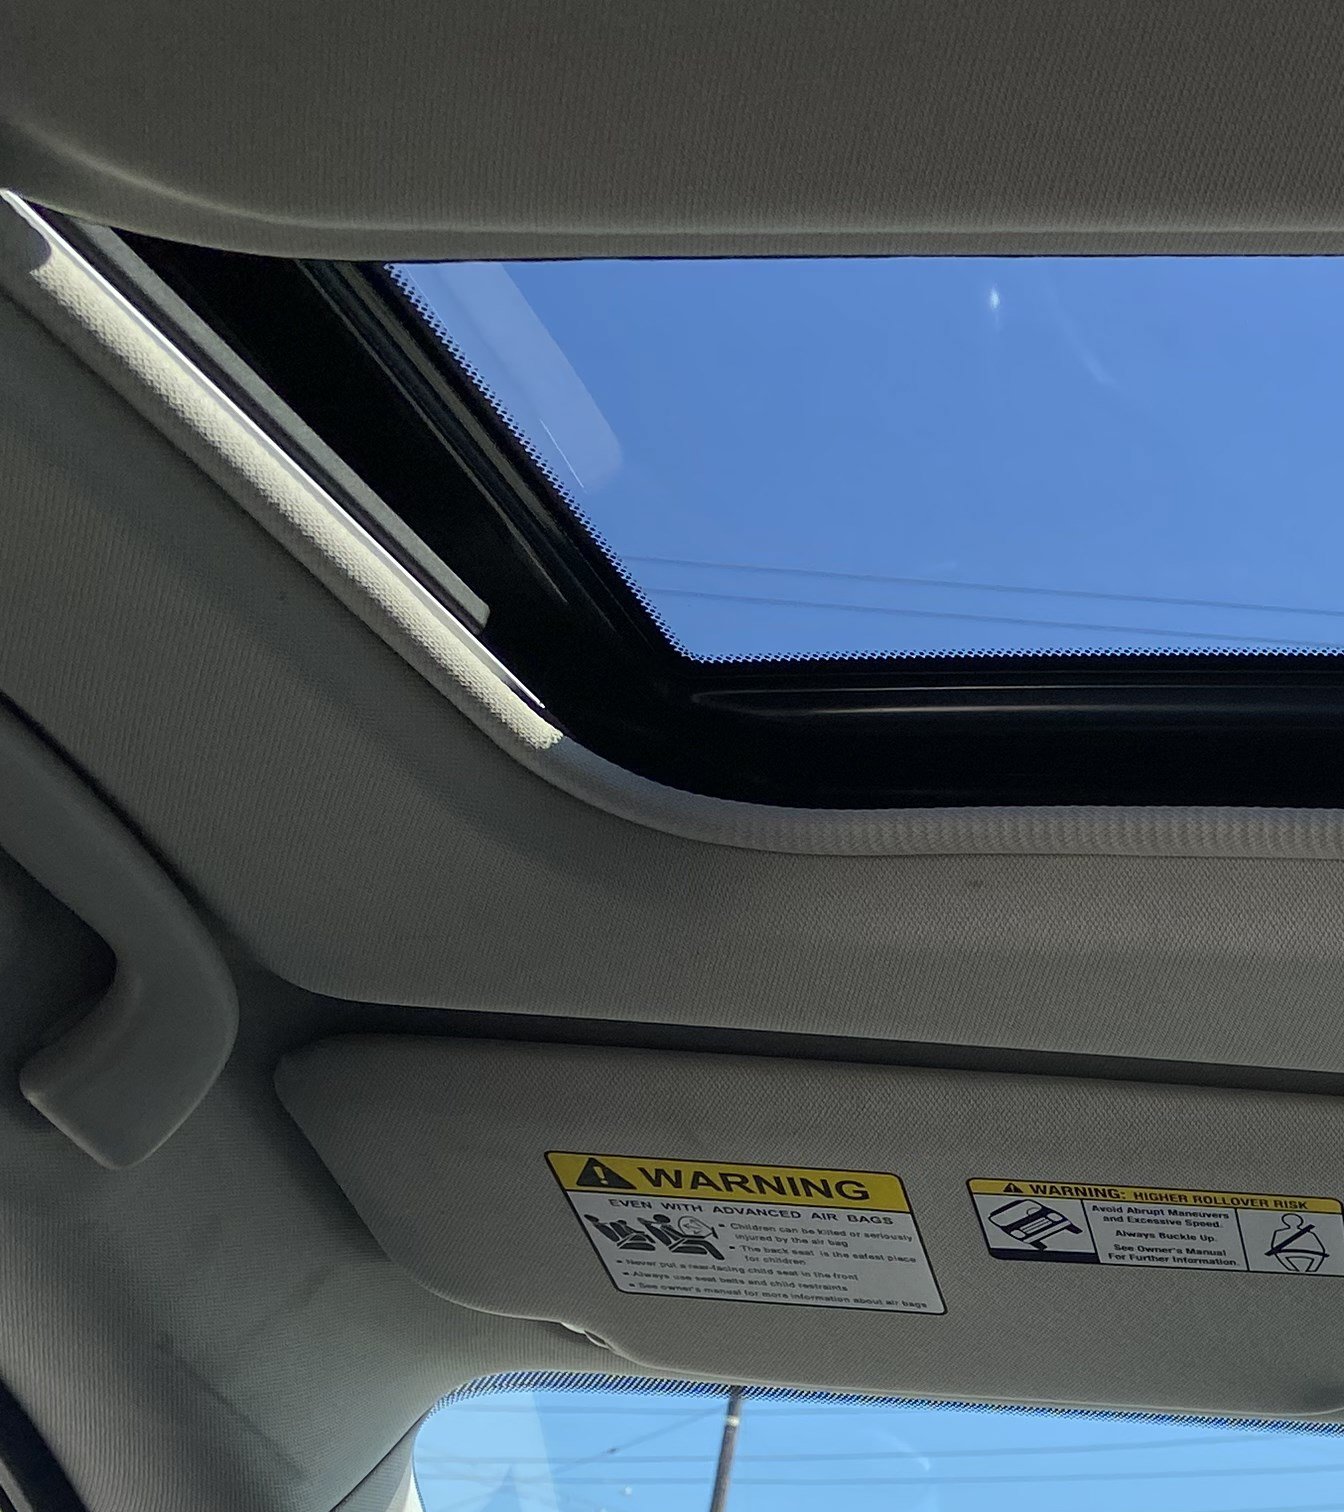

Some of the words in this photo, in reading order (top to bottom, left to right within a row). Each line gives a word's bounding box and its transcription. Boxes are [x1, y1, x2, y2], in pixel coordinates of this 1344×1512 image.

[637, 1167, 870, 1200] WARNING
[1029, 1184, 1126, 1199] WARNING:
[1134, 1192, 1188, 1203] HIGHER
[1192, 1194, 1268, 1208] ROLLOVER
[1274, 1199, 1308, 1210] RISK
[608, 1199, 652, 1209] EVEN
[661, 1203, 703, 1212] WITH
[713, 1206, 801, 1219] ADVANCED
[811, 1212, 838, 1221] AIR
[847, 1214, 893, 1225] BAGS
[1092, 1204, 1123, 1214] Avoid
[1127, 1206, 1165, 1217] Abrupt
[1168, 1208, 1229, 1219] Maneuvers
[1103, 1214, 1123, 1222] and
[1127, 1216, 1181, 1226] Excessive
[1185, 1218, 1223, 1228] Speed.
[730, 1222, 776, 1233] Children
[779, 1226, 798, 1234] can
[802, 1226, 815, 1235] be
[818, 1227, 846, 1237] killed
[864, 1231, 912, 1242] seriously
[1115, 1230, 1156, 1240] Always
[1159, 1232, 1196, 1241] Buckle
[1200, 1234, 1217, 1243] Up.
[735, 1233, 772, 1243] injured
[775, 1235, 787, 1244] by
[791, 1236, 808, 1244] the
[828, 1239, 848, 1248] bag
[740, 1244, 760, 1252] The
[763, 1245, 788, 1254] back
[792, 1248, 814, 1256] seat
[820, 1249, 829, 1257] is
[832, 1250, 849, 1258] the
[852, 1251, 884, 1260] safest
[887, 1255, 916, 1263] place
[1113, 1244, 1134, 1252] See
[1139, 1245, 1183, 1254] Owner's
[1186, 1247, 1226, 1256] Manual
[763, 1256, 806, 1265] children
[1108, 1253, 1125, 1261] For
[1129, 1254, 1169, 1263] Further
[1173, 1256, 1239, 1266] Information.
